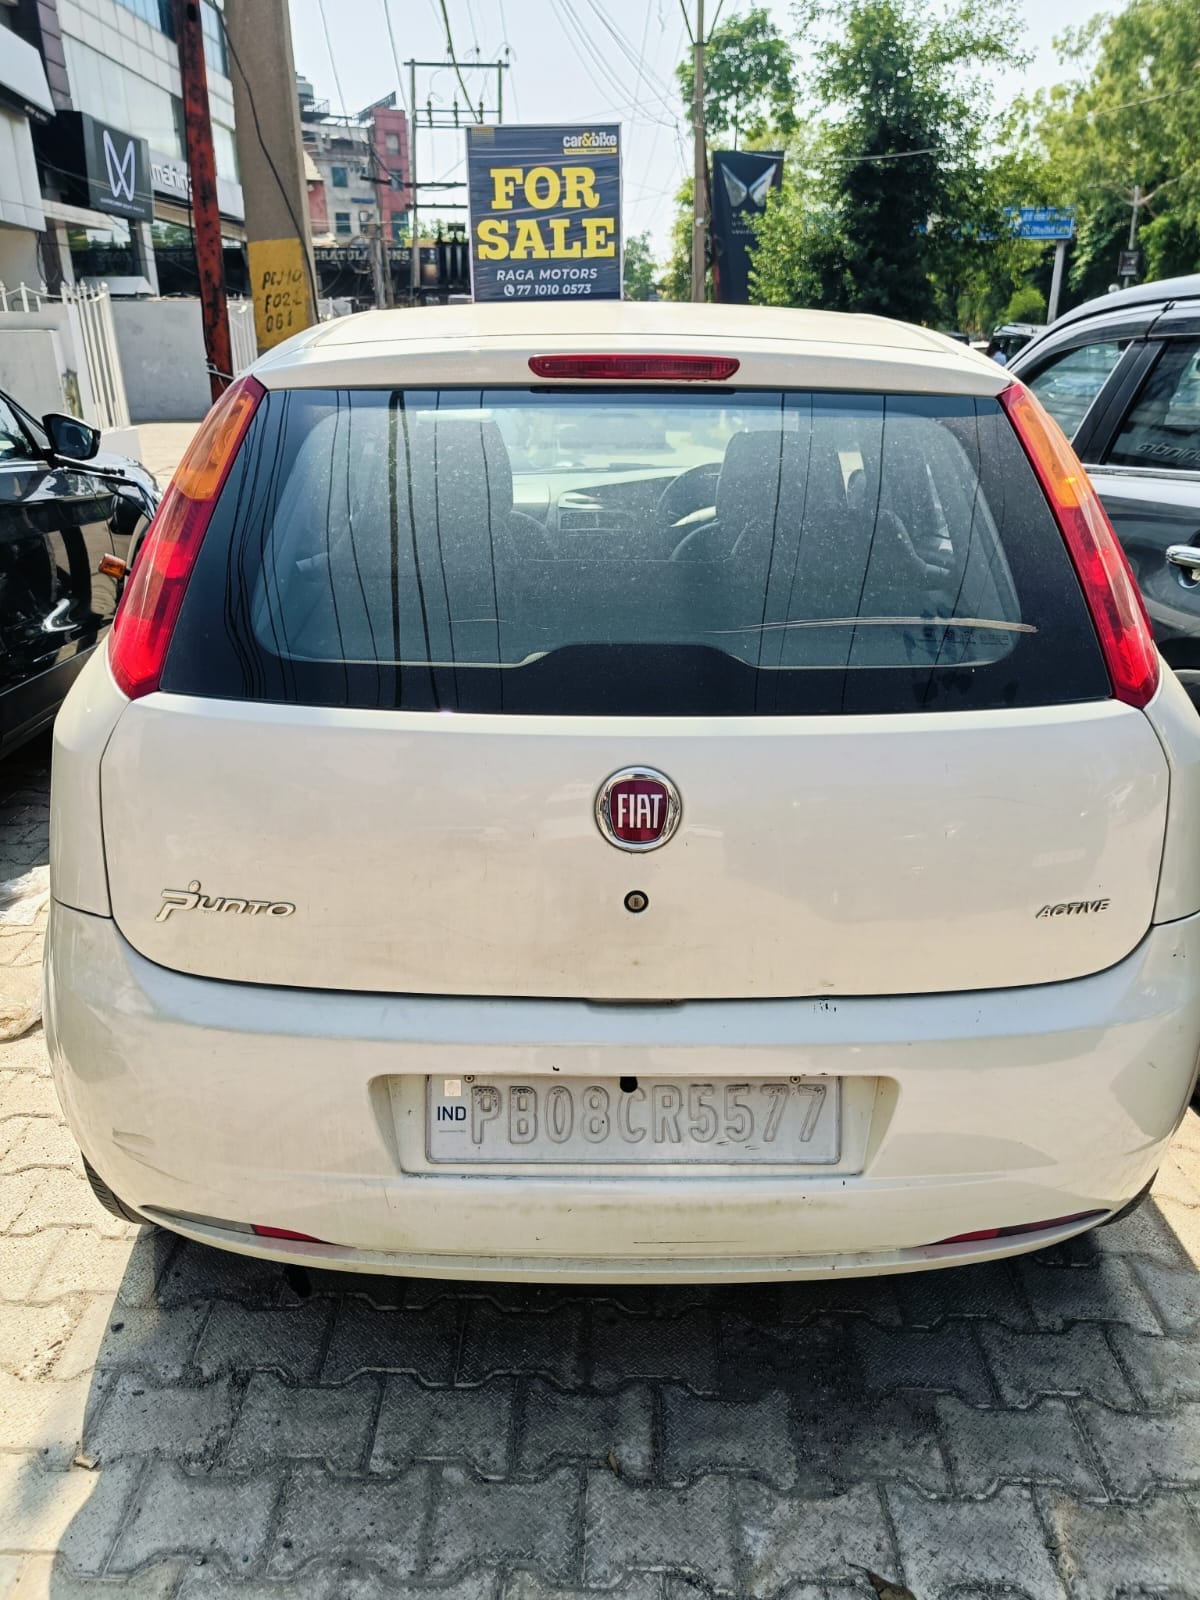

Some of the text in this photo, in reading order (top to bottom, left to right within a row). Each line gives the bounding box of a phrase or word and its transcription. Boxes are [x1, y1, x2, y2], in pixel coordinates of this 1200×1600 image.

[562, 131, 618, 148] car&bike
[490, 166, 600, 210] FOR
[476, 217, 616, 261] SALE
[496, 268, 598, 281] RAGA MOTORS
[534, 284, 560, 296] 1010
[562, 283, 592, 295] 0573
[617, 793, 663, 829] FIAT
[1035, 898, 1111, 919] ACTIVE
[437, 1105, 467, 1121] IND
[471, 1084, 827, 1145] PB08CR5577
